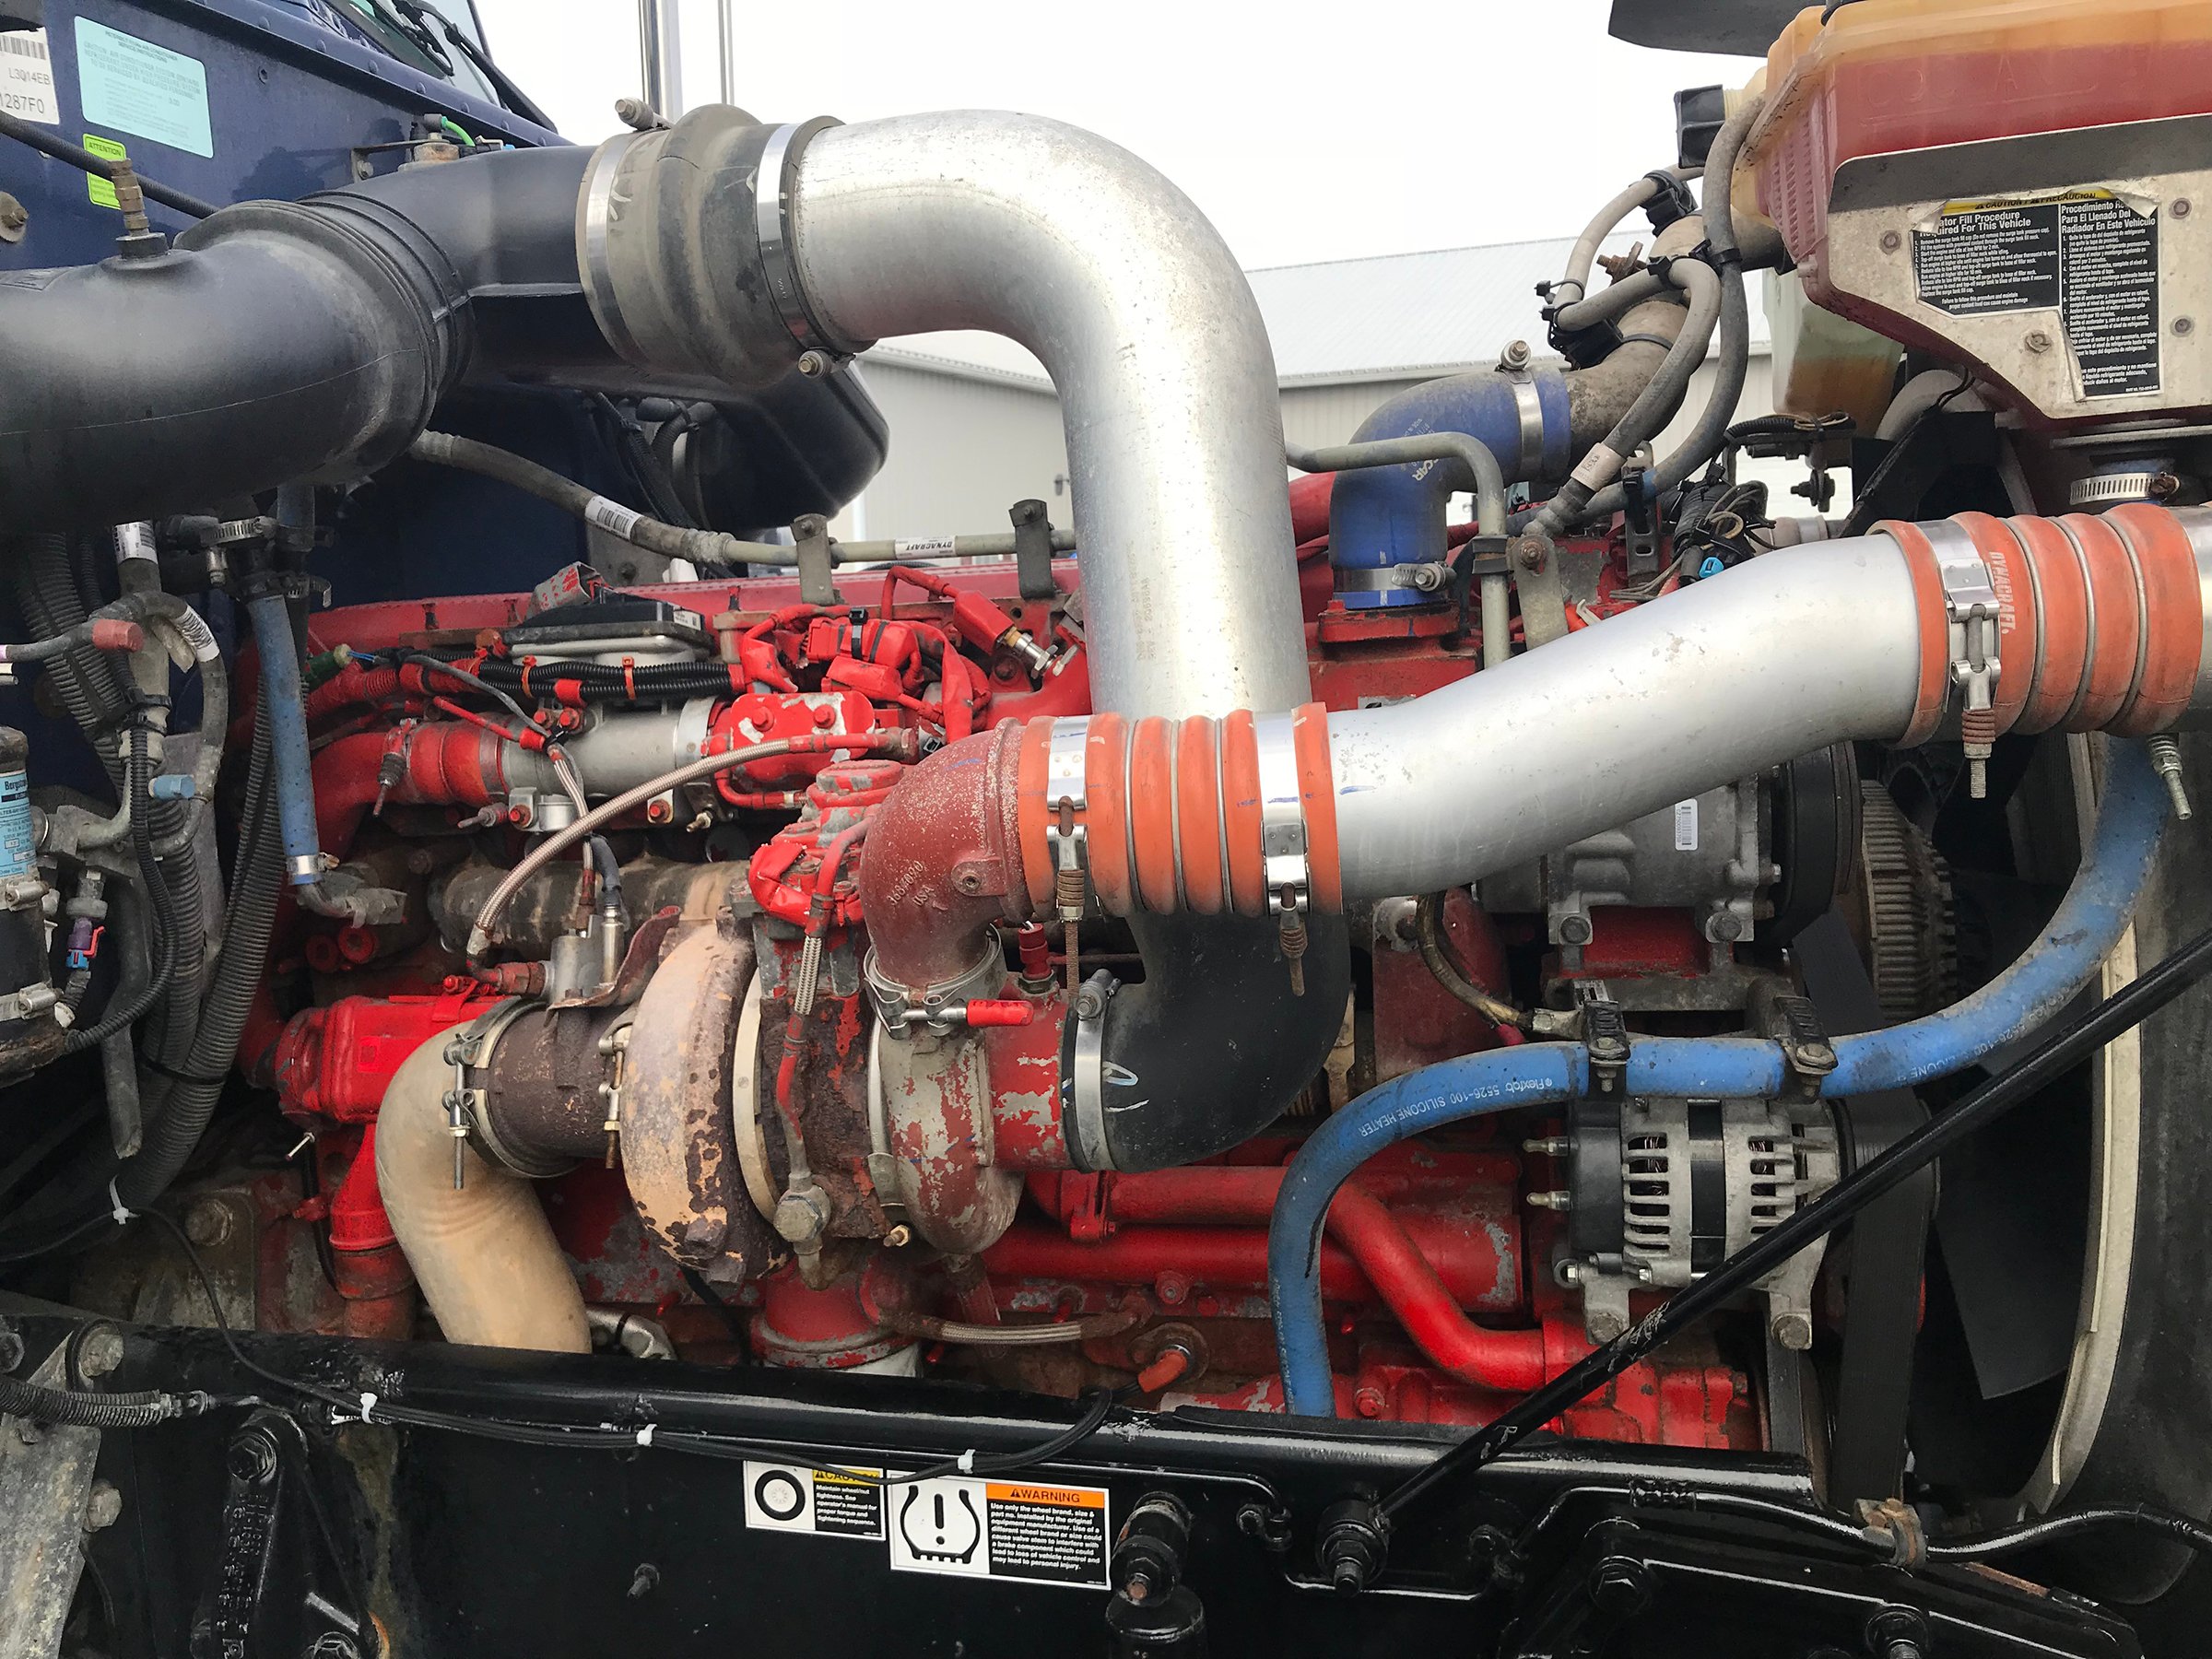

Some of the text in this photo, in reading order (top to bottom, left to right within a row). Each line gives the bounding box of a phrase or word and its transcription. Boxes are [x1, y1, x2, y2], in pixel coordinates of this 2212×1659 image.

[88, 142, 122, 157] ATTENTION
[2061, 201, 2113, 214] Procedimiento
[1939, 211, 2020, 227] ator Fill Procedure
[2061, 209, 2131, 224] Para El Llenado Del
[1961, 224, 1976, 233] For
[1978, 221, 1997, 231] This
[1999, 218, 2031, 229] Vehicle
[2062, 223, 2094, 234] Radiador
[2096, 221, 2105, 230] En
[2107, 220, 2123, 229] Este
[905, 541, 953, 551] DYNACRAFT
[912, 884, 936, 906] USA
[1359, 1077, 1545, 1137] Flexfab 5526-100 SILICONE HEATER
[816, 1484, 841, 1492] Maintain
[816, 1492, 844, 1500] tightness.
[1020, 1488, 1080, 1503] WARNING
[1004, 1503, 1019, 1512] only
[1052, 1508, 1074, 1516] brand,
[817, 1515, 846, 1524] tightening
[990, 1510, 1005, 1518] part
[1016, 1512, 1045, 1521] installed
[1066, 1516, 1092, 1525] original
[990, 1518, 1025, 1527] equipment
[1026, 1521, 1072, 1531] manufacturer.
[991, 1525, 1018, 1534] different
[1018, 1527, 1039, 1535] wheel
[1039, 1529, 1059, 1537] brand
[1083, 1533, 1102, 1541] could
[1016, 1543, 1053, 1552] component
[1055, 1538, 1084, 1547] interfere
[1015, 1549, 1030, 1558] loss
[1038, 1552, 1062, 1560] vehicle
[1062, 1554, 1087, 1562] control
[1030, 1559, 1059, 1568] personal
[1059, 1561, 1081, 1570] injury.
